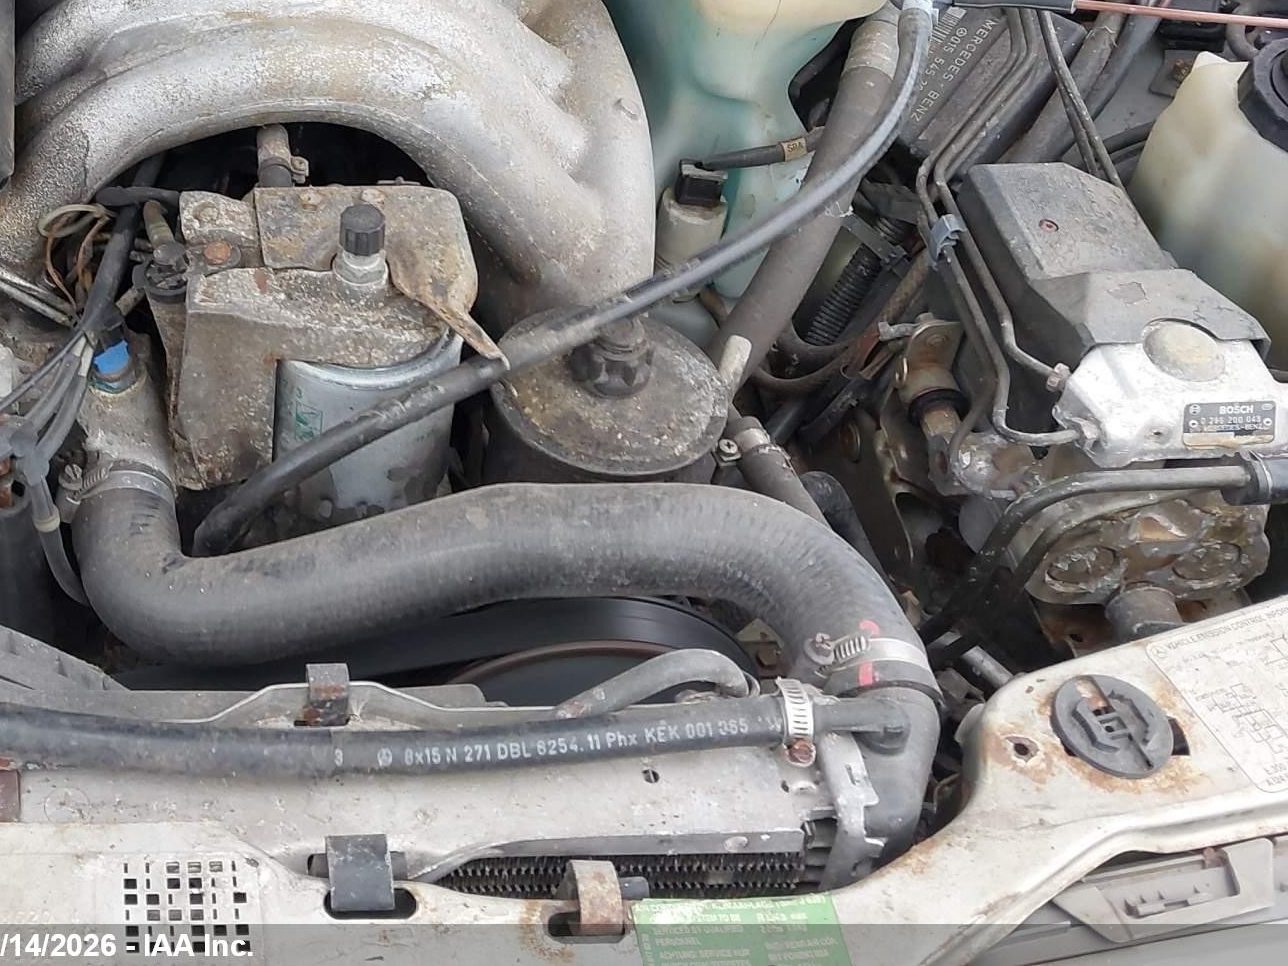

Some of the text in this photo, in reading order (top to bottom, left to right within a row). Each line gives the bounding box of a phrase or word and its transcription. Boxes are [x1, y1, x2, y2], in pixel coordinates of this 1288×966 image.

[910, 17, 1001, 122] MERCEDES BENZ
[1219, 404, 1254, 415] BOSCH
[446, 747, 458, 763] N
[464, 744, 491, 763] 271
[496, 742, 532, 761] DBL
[606, 731, 638, 749] Phx
[685, 722, 712, 740] 001
